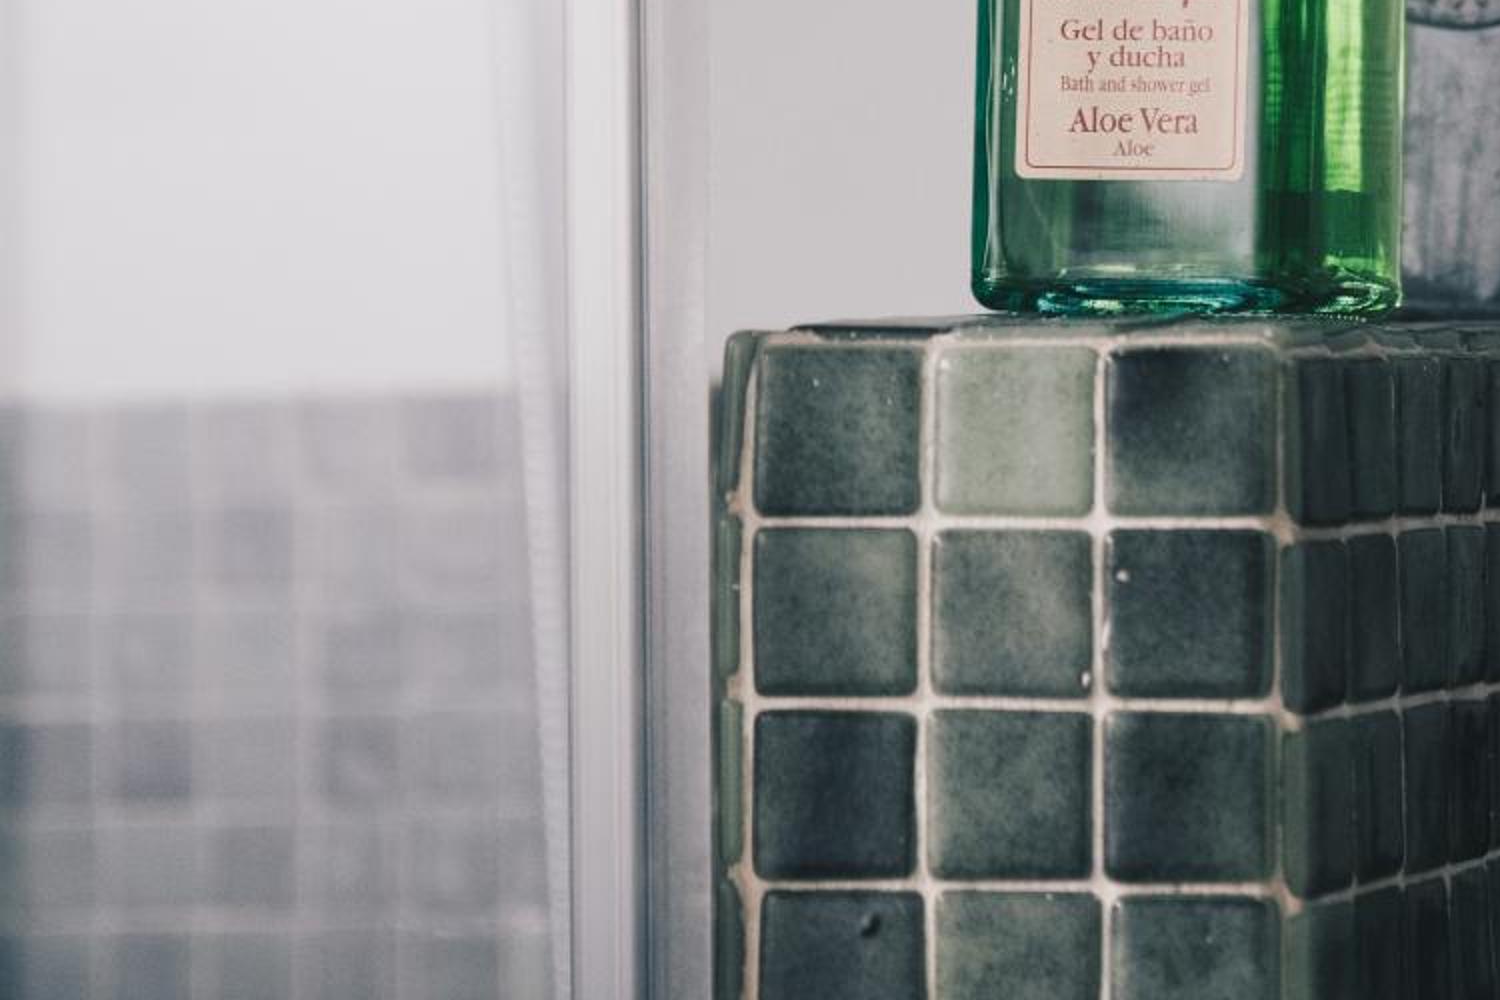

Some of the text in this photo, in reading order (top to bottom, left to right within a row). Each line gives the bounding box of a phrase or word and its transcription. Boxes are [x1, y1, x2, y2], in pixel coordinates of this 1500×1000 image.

[1061, 18, 1213, 42] Gel de baño
[1087, 46, 1185, 73] y ducha
[1061, 75, 1212, 96] Bath and shower gel
[1068, 106, 1198, 134] Aloe Vera
[1113, 140, 1154, 157] Aloe
